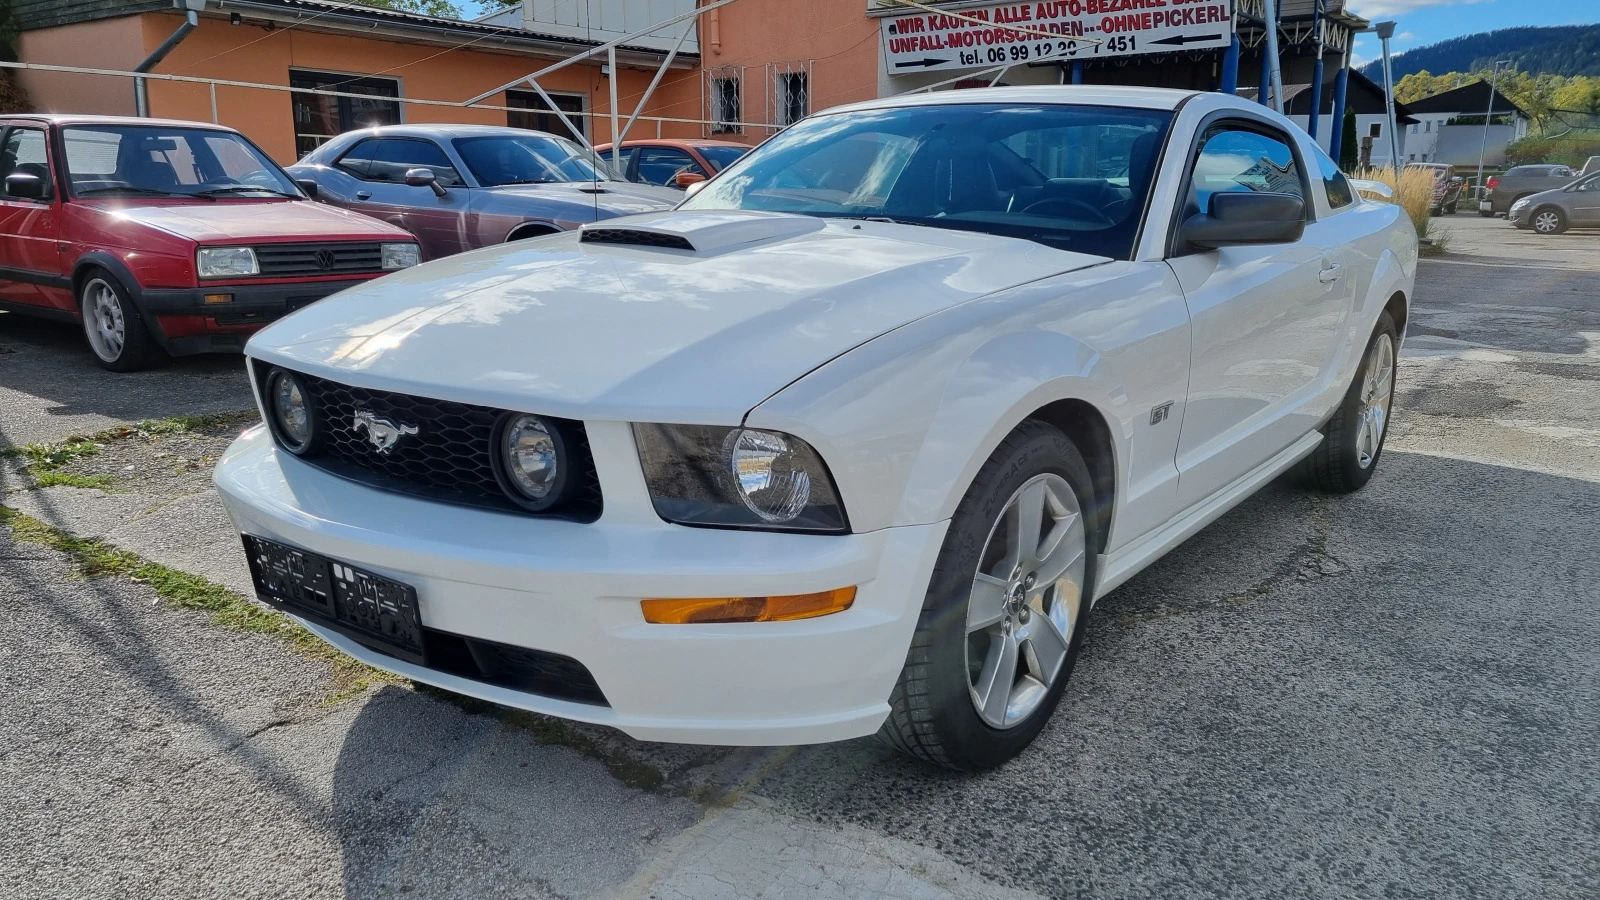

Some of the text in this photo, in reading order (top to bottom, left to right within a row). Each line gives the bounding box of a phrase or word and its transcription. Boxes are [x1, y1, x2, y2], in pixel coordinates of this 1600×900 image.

[896, 17, 925, 34] WIR
[928, 8, 989, 30] KAUFEN
[994, 4, 1032, 24] ALLE
[959, 49, 984, 65] tel.
[987, 47, 1006, 62] 06
[1009, 45, 1029, 60] 99
[1035, 44, 1053, 57] 12
[1107, 35, 1136, 52] 451
[1150, 400, 1175, 426] GT
